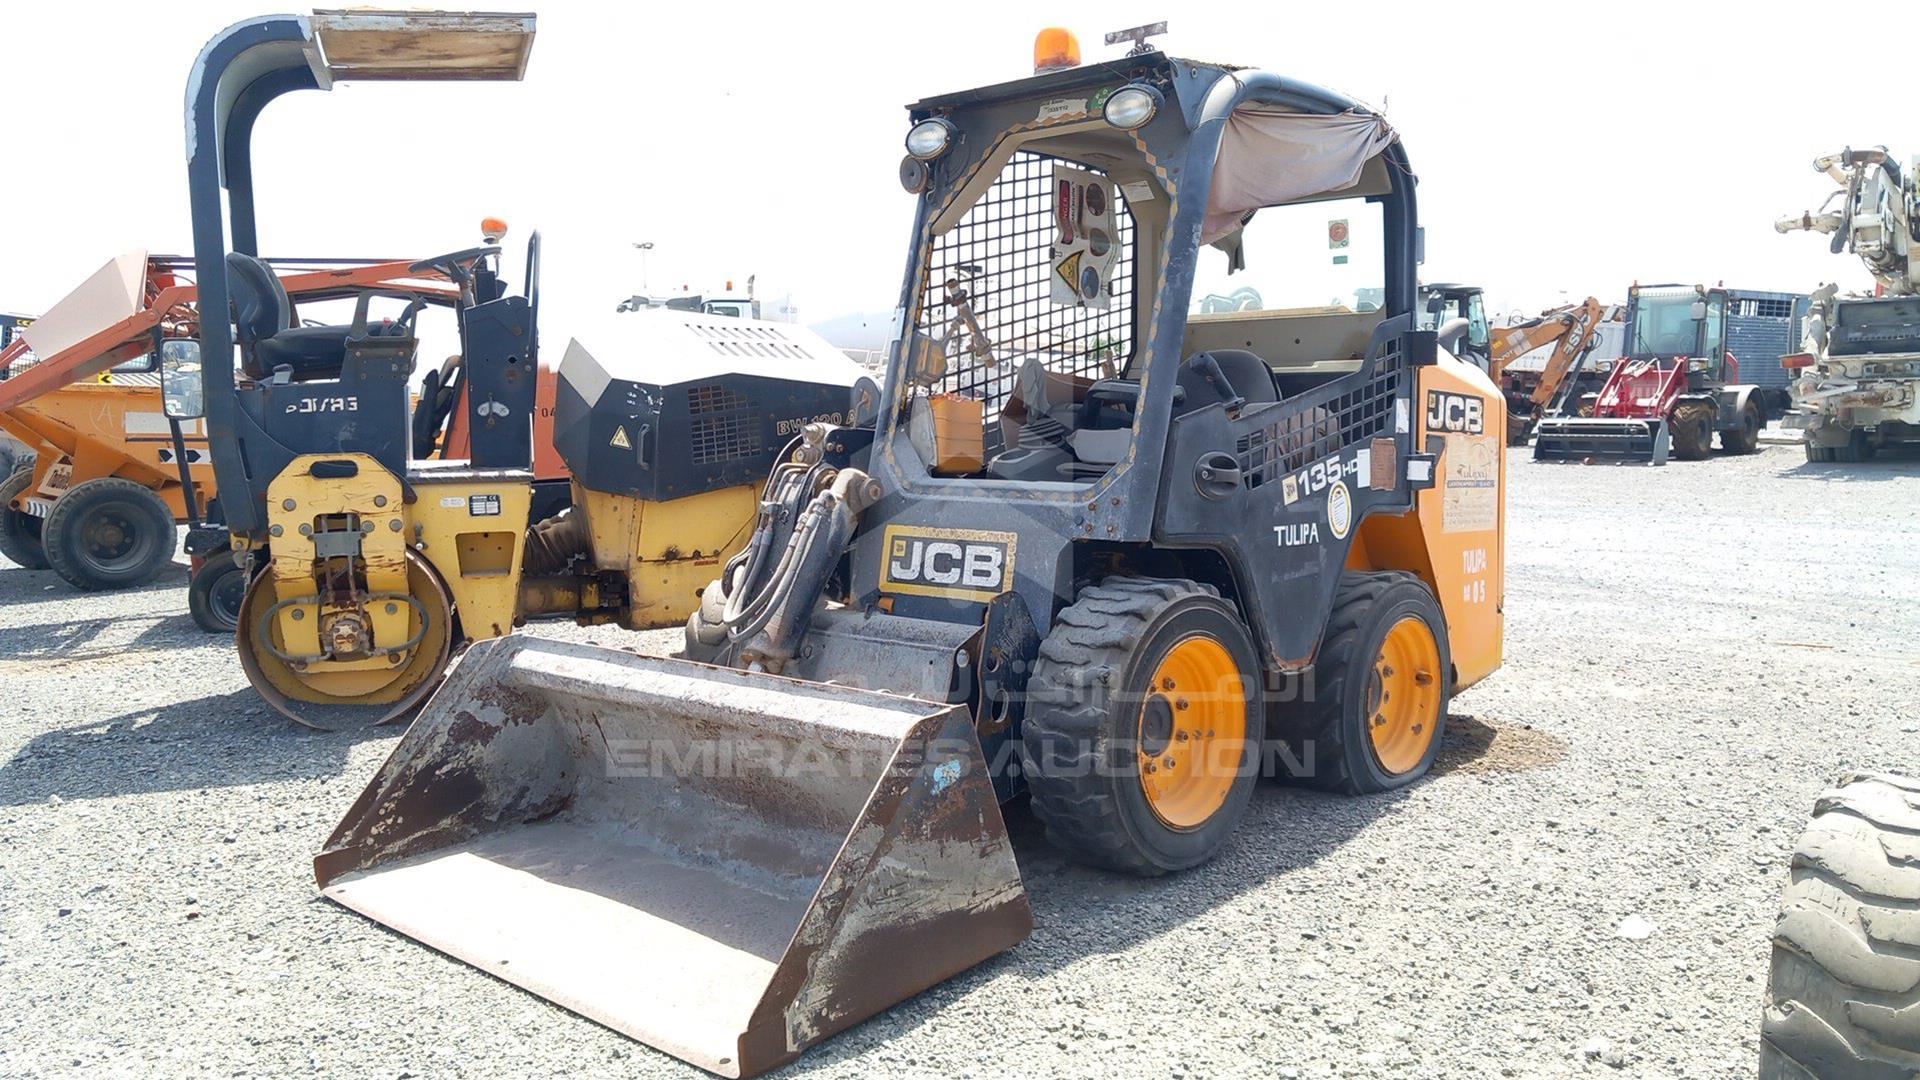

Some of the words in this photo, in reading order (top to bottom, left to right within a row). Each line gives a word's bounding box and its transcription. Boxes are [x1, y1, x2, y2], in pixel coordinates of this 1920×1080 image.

[1428, 395, 1483, 432] JCB
[1273, 523, 1320, 547] TULIPA
[891, 541, 1002, 587] JCB
[1463, 549, 1488, 574] TULIPA
